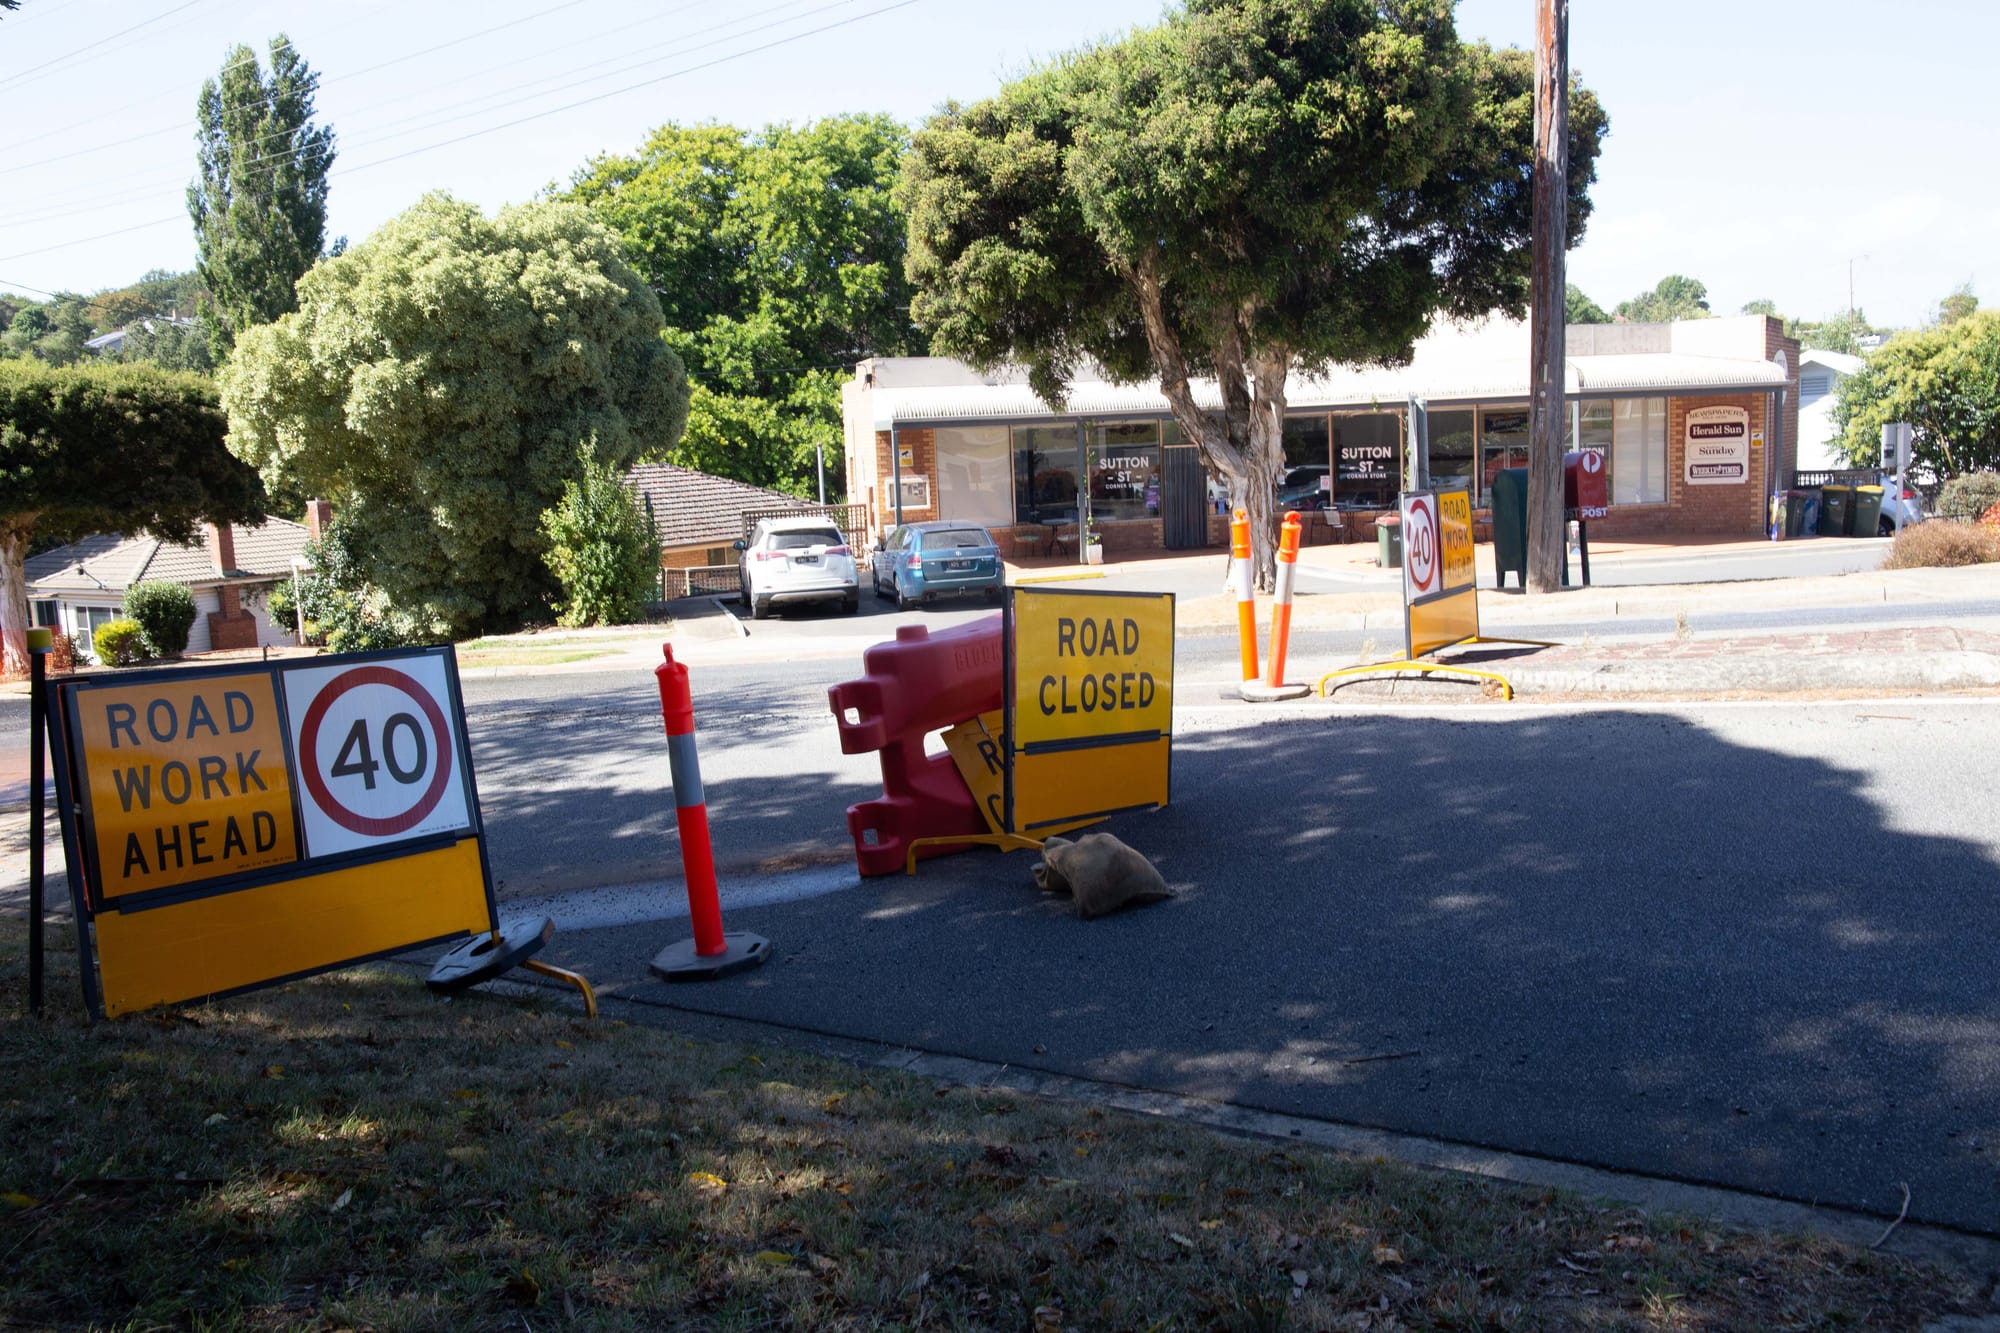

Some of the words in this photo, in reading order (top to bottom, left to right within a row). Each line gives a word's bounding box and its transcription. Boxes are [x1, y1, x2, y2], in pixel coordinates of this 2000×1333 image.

[1689, 409, 1744, 419] NEWSPAPERS
[1692, 425, 1722, 436] Herald
[1723, 425, 1742, 434] Sun
[1341, 446, 1392, 459] SUTTON
[1699, 446, 1736, 456] Sunday
[1100, 456, 1149, 470] SUTTON
[1359, 460, 1374, 472] ST
[1117, 470, 1132, 482] ST
[1443, 498, 1467, 521] ROAD
[1581, 507, 1608, 518] POST
[1412, 525, 1431, 567] 40
[1445, 527, 1470, 552] WORK
[1447, 556, 1472, 578] AHEAD
[1058, 617, 1140, 657] ROAD
[1039, 671, 1155, 716] CLOSED
[106, 691, 254, 749] ROAD
[330, 712, 428, 790] 40
[112, 750, 268, 813] WORK
[123, 810, 277, 878] AHEAD
